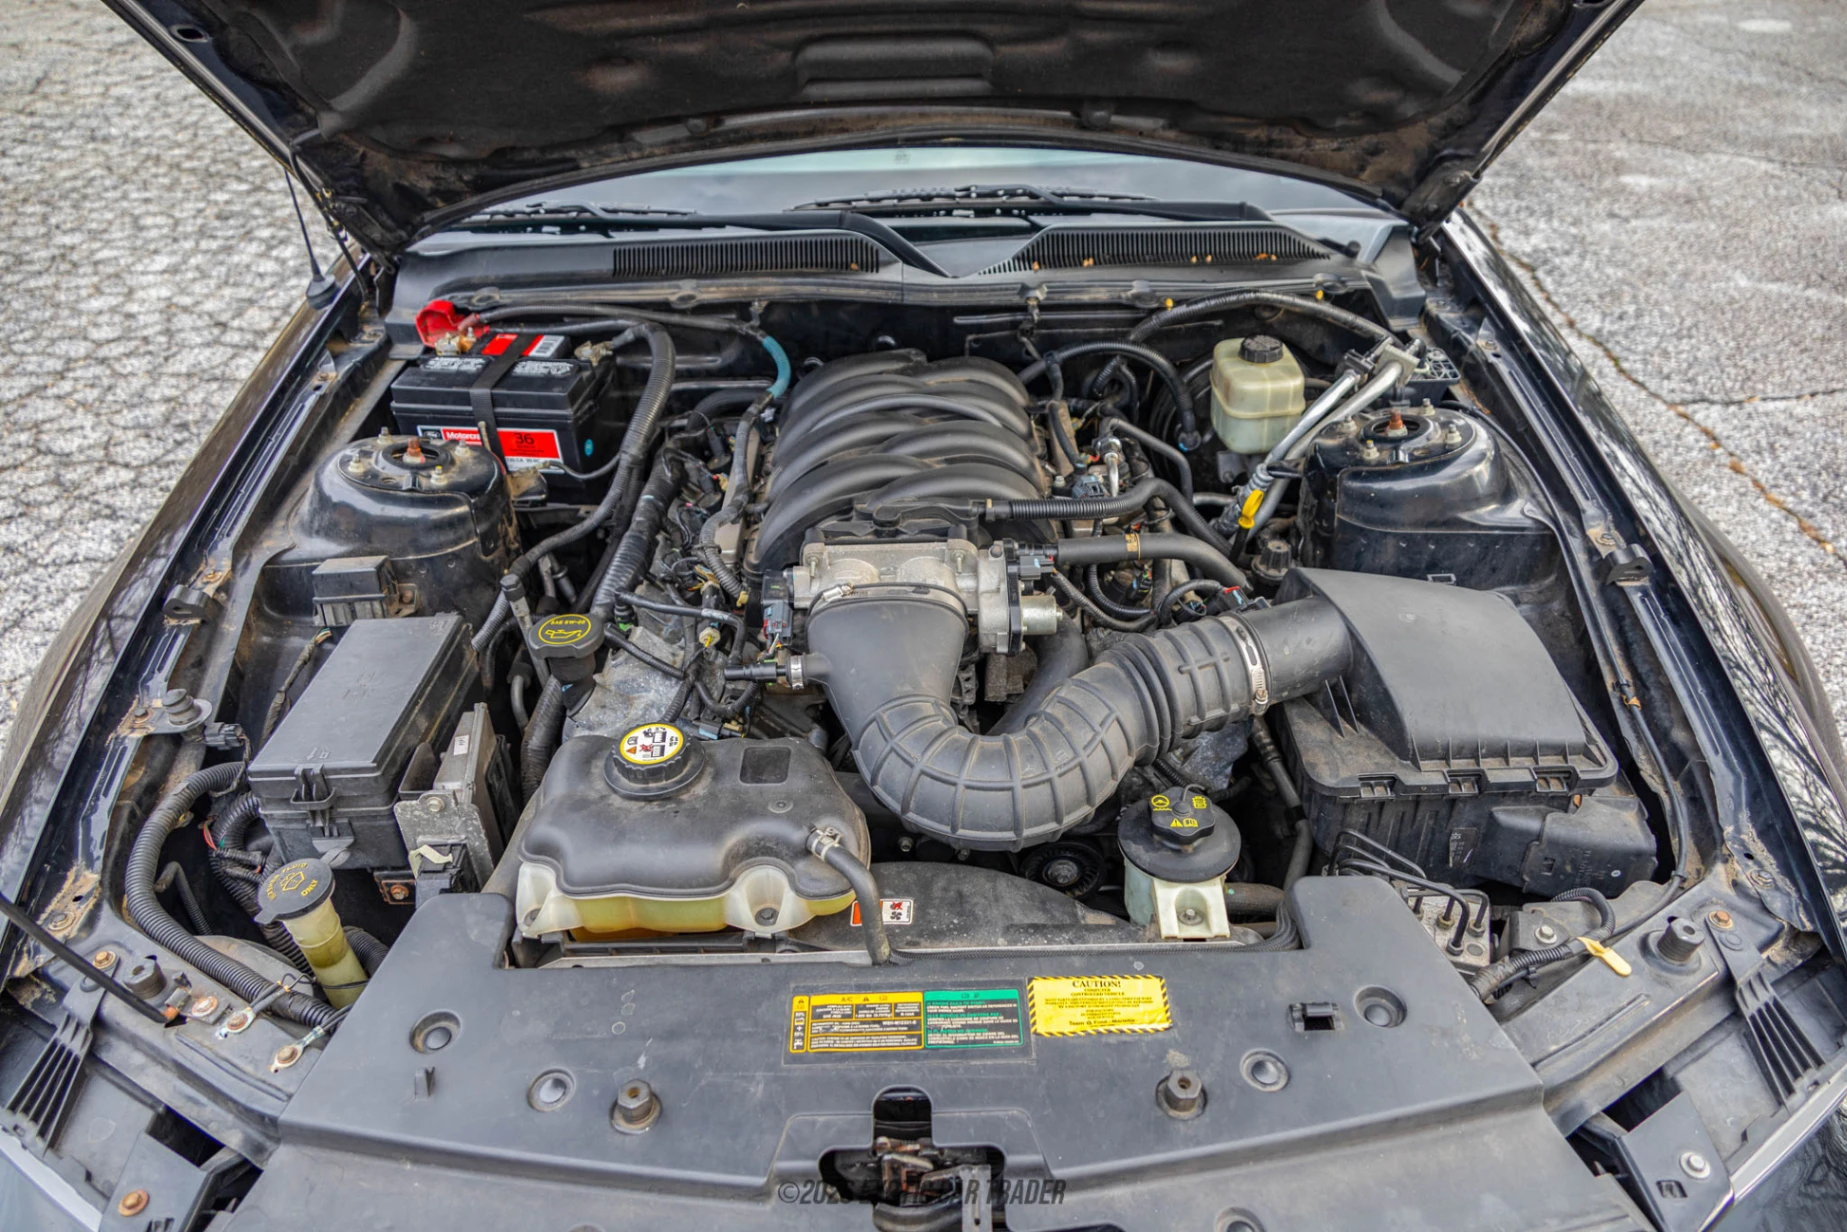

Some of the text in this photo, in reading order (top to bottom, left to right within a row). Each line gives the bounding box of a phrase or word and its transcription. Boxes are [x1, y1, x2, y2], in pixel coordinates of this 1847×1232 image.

[513, 432, 535, 445] 36
[301, 879, 318, 897] ONLY
[1072, 980, 1121, 988] CAUTION!
